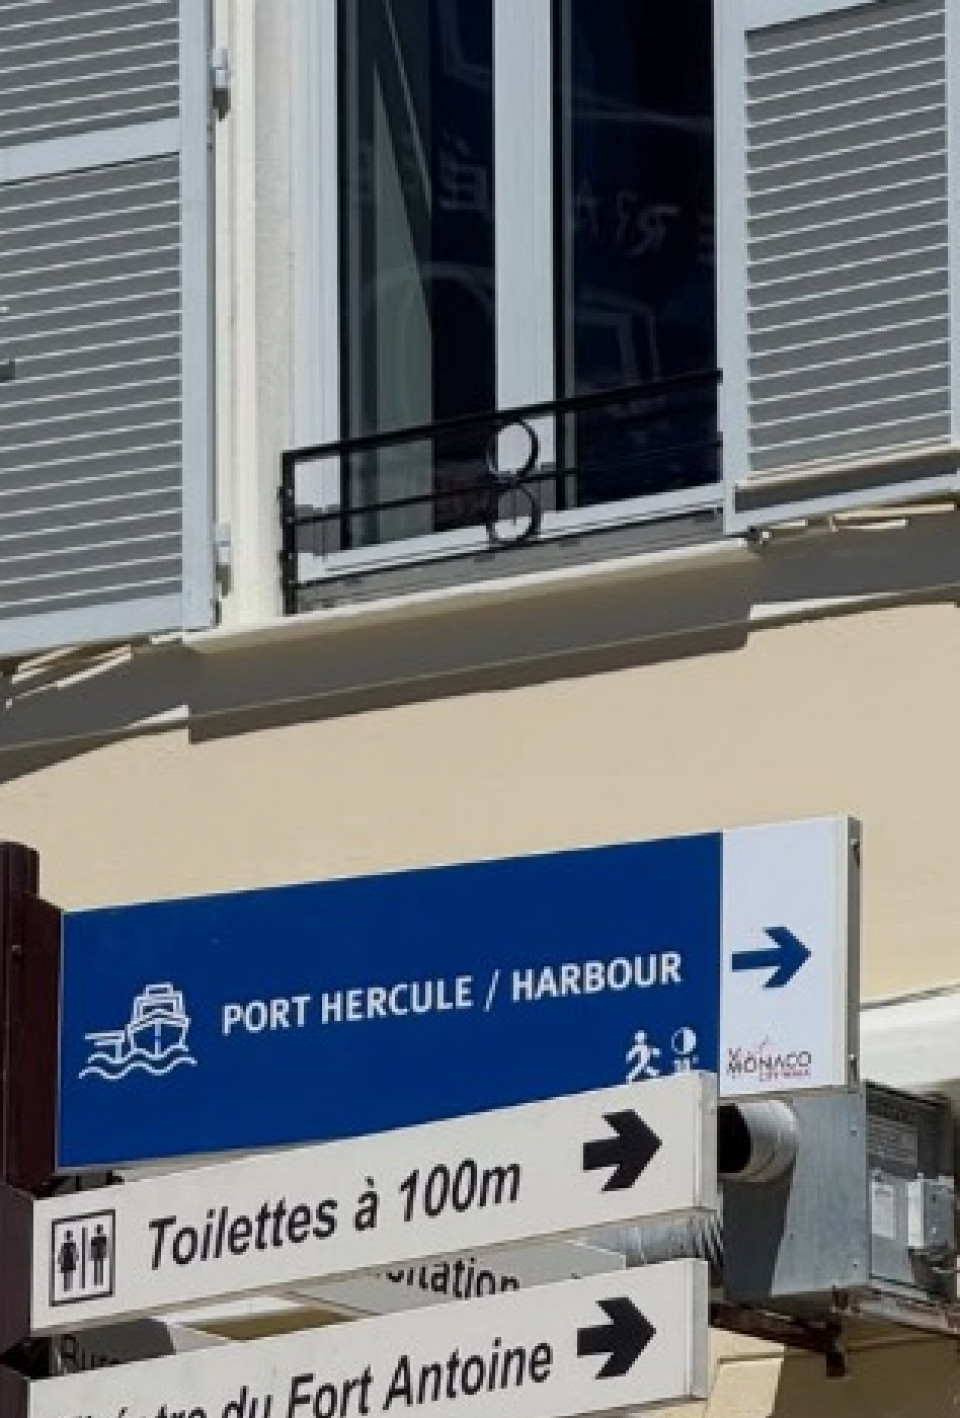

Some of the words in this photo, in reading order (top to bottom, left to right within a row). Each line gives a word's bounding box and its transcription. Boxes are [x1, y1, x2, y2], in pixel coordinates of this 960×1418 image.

[223, 995, 311, 1035] PORT
[321, 976, 473, 1025] HERCULE
[485, 968, 499, 1013] /
[512, 951, 683, 1001] HARBOUR
[147, 1196, 338, 1270] Toilettes
[354, 1175, 378, 1231] à
[398, 1158, 521, 1222] 100m
[385, 1335, 554, 1407] Antoine
